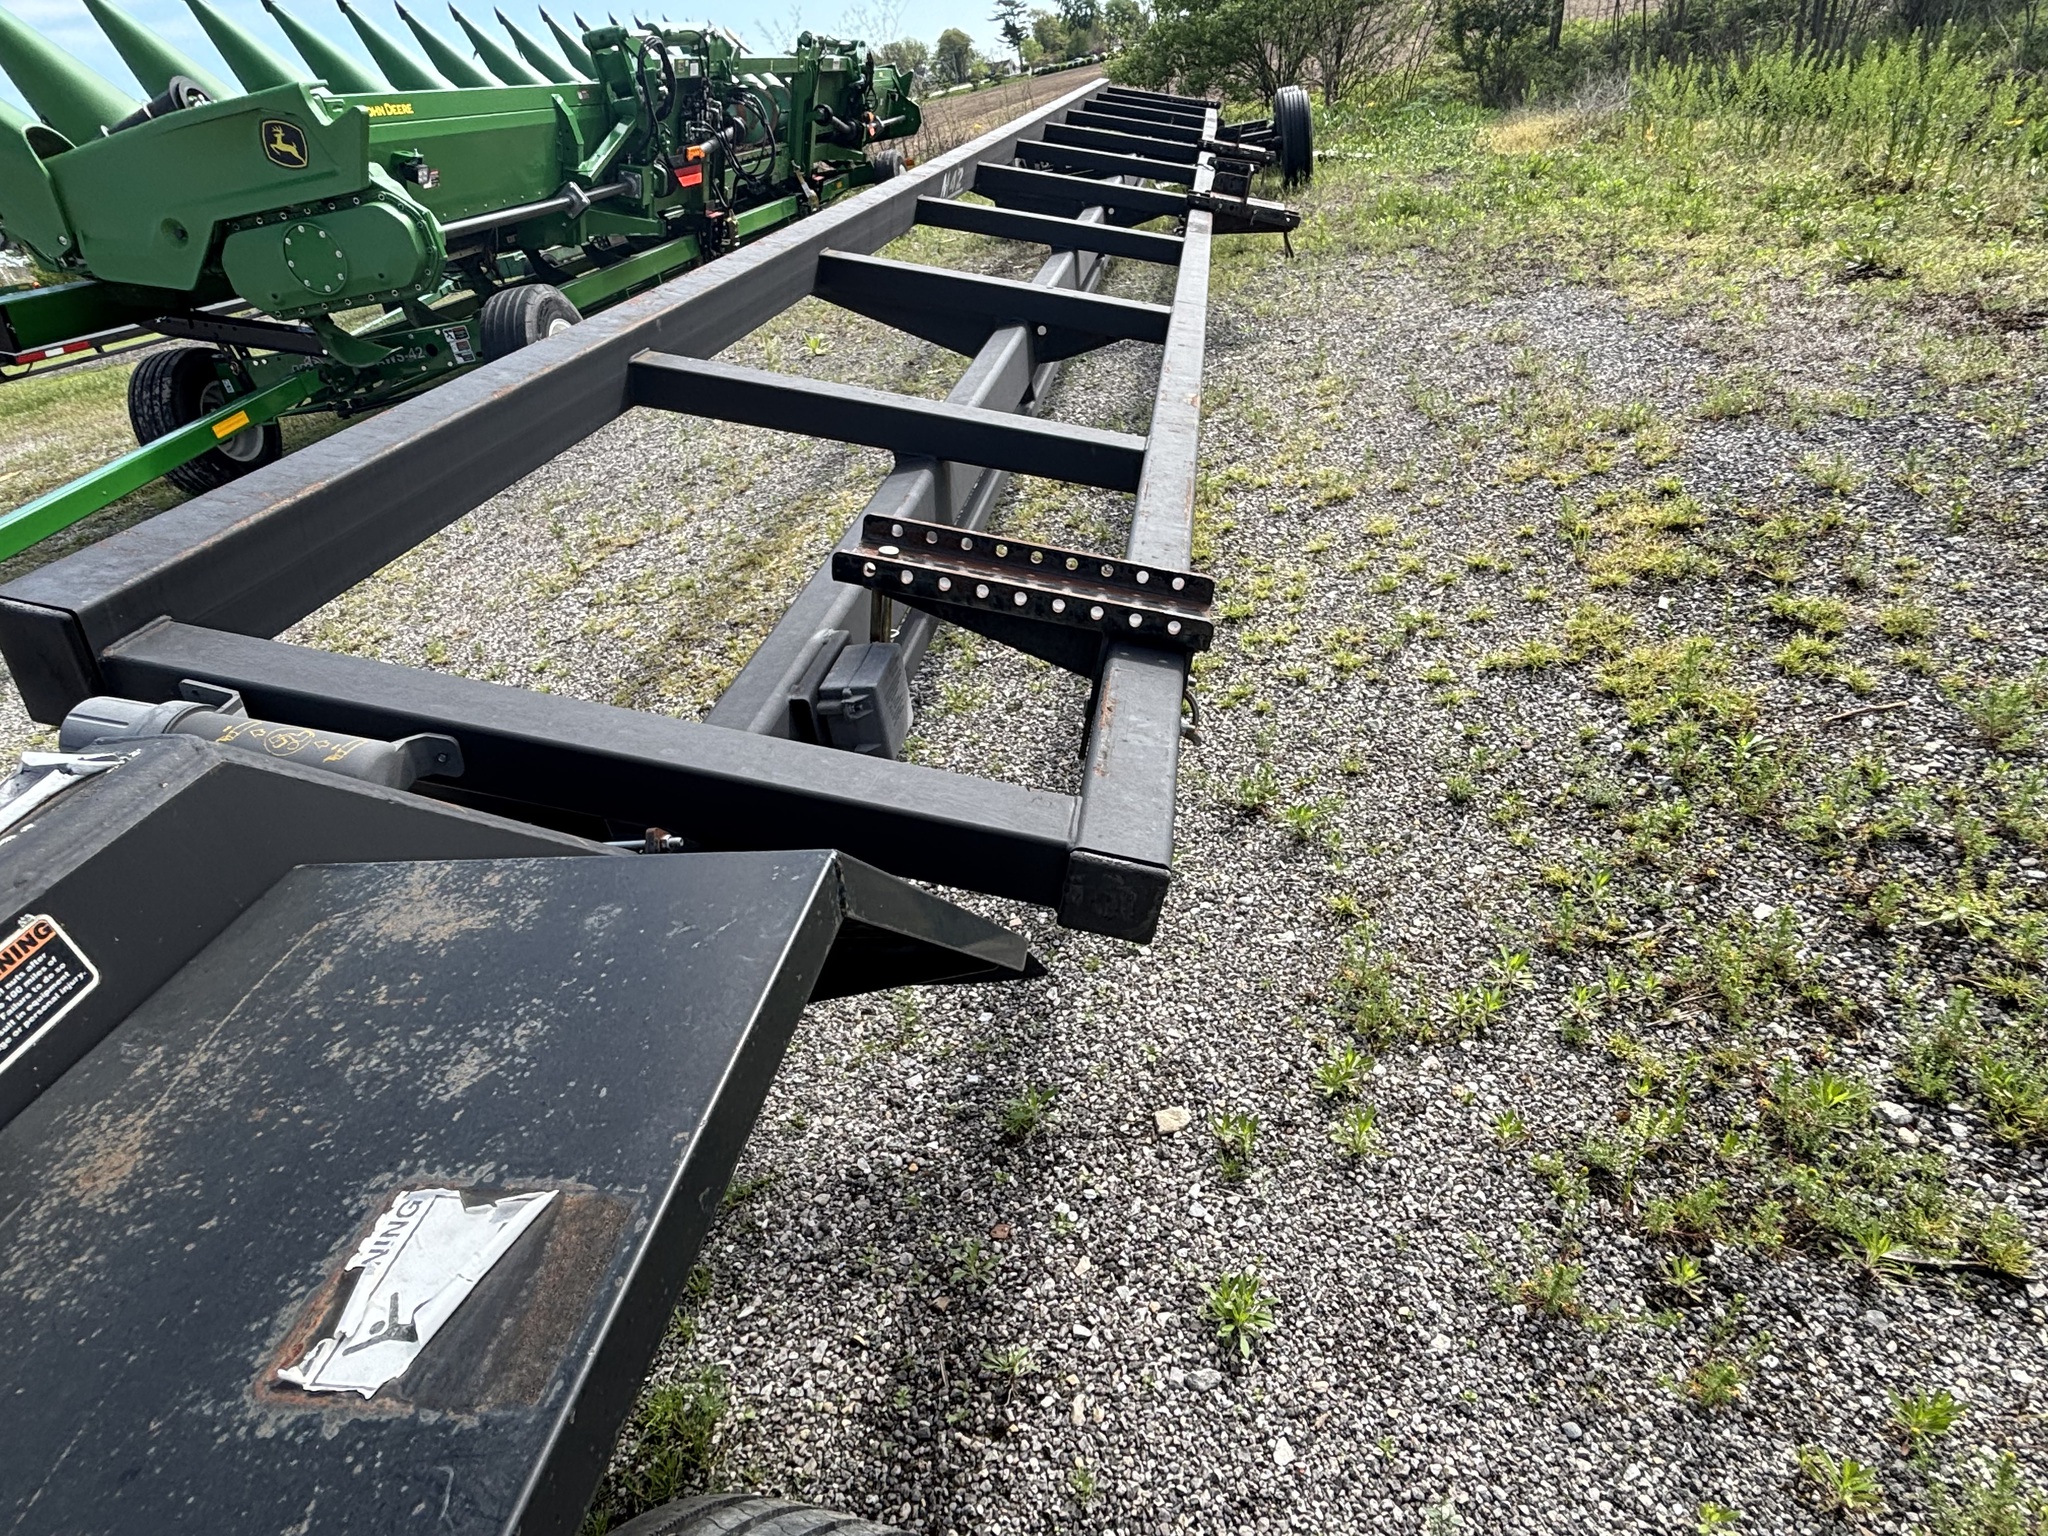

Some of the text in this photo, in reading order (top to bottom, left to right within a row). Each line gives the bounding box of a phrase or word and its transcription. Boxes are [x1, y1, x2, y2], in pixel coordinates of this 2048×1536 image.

[368, 102, 414, 117] OHN DEERE
[0, 921, 53, 976] NING
[5, 952, 47, 989] nuts after
[0, 992, 32, 1020] Failure
[31, 983, 43, 993] to
[43, 972, 55, 984] do
[54, 962, 66, 973] so
[5, 985, 23, 1001] 100
[23, 966, 47, 987] miles
[47, 955, 57, 967] of
[12, 1026, 23, 1037] or
[23, 992, 60, 1029] personal
[59, 971, 88, 995] injury.
[15, 1010, 26, 1021] in
[26, 971, 71, 1011] equipment
[361, 1199, 423, 1266] NING
